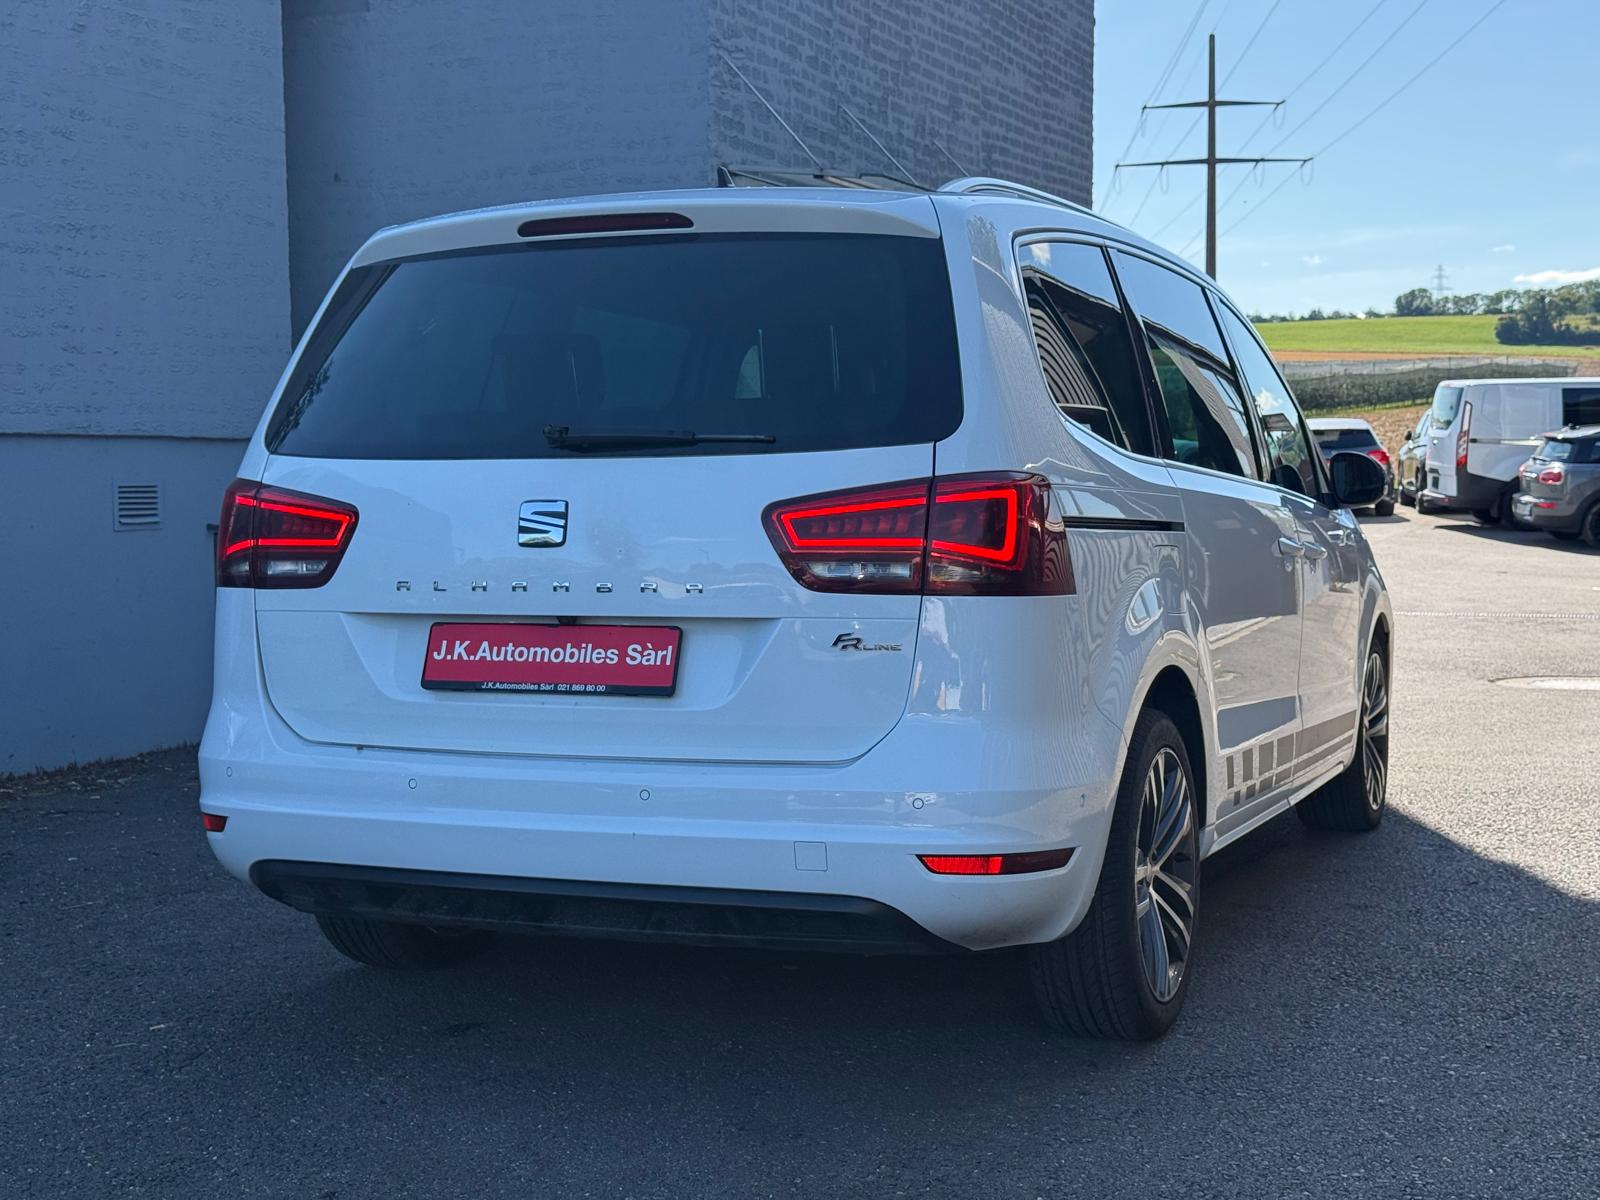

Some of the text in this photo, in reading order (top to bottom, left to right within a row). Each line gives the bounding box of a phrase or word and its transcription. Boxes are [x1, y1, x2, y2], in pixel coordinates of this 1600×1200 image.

[396, 580, 704, 594] ALHAMBRA
[433, 640, 673, 666] J.K.Automobiles Sàrl
[586, 684, 596, 692] 80
[596, 684, 606, 692] 00
